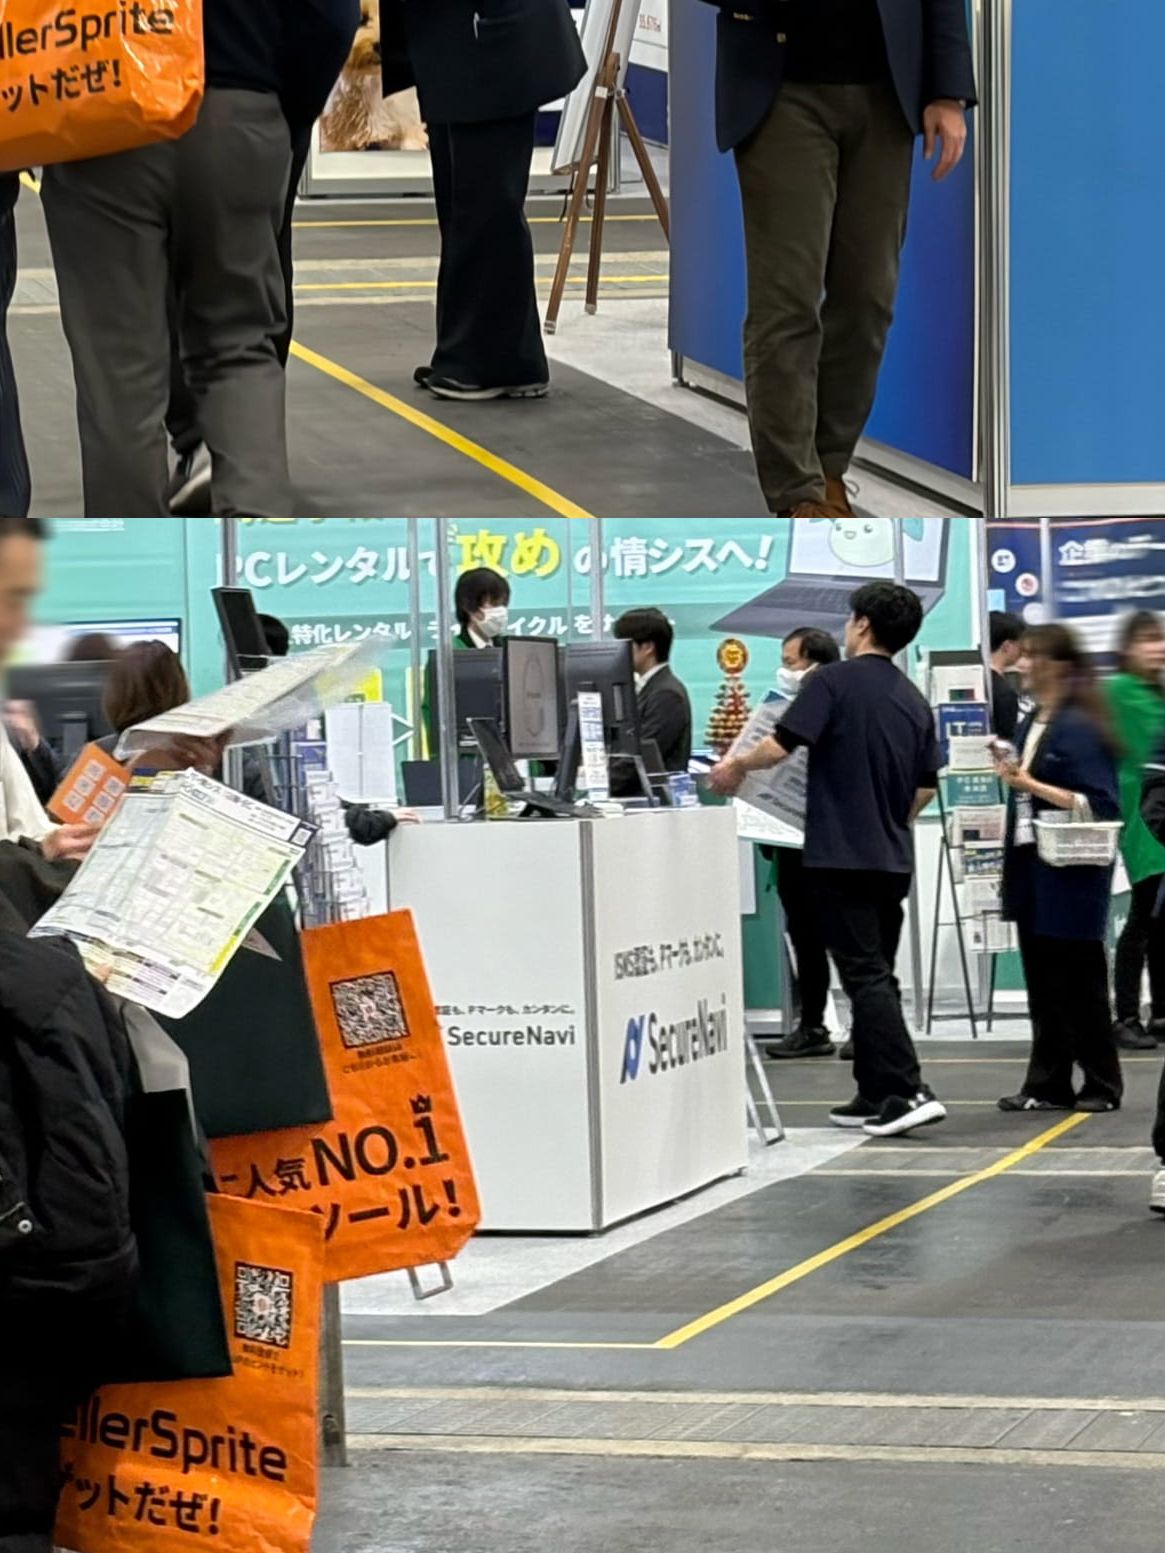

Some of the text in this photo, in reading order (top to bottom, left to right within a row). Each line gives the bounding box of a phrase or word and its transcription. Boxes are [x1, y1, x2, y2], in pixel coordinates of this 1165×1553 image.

[447, 1025, 576, 1046] SecureNavi
[648, 993, 728, 1074] SecureNavi
[203, 1115, 450, 1199] ー人気NO.1
